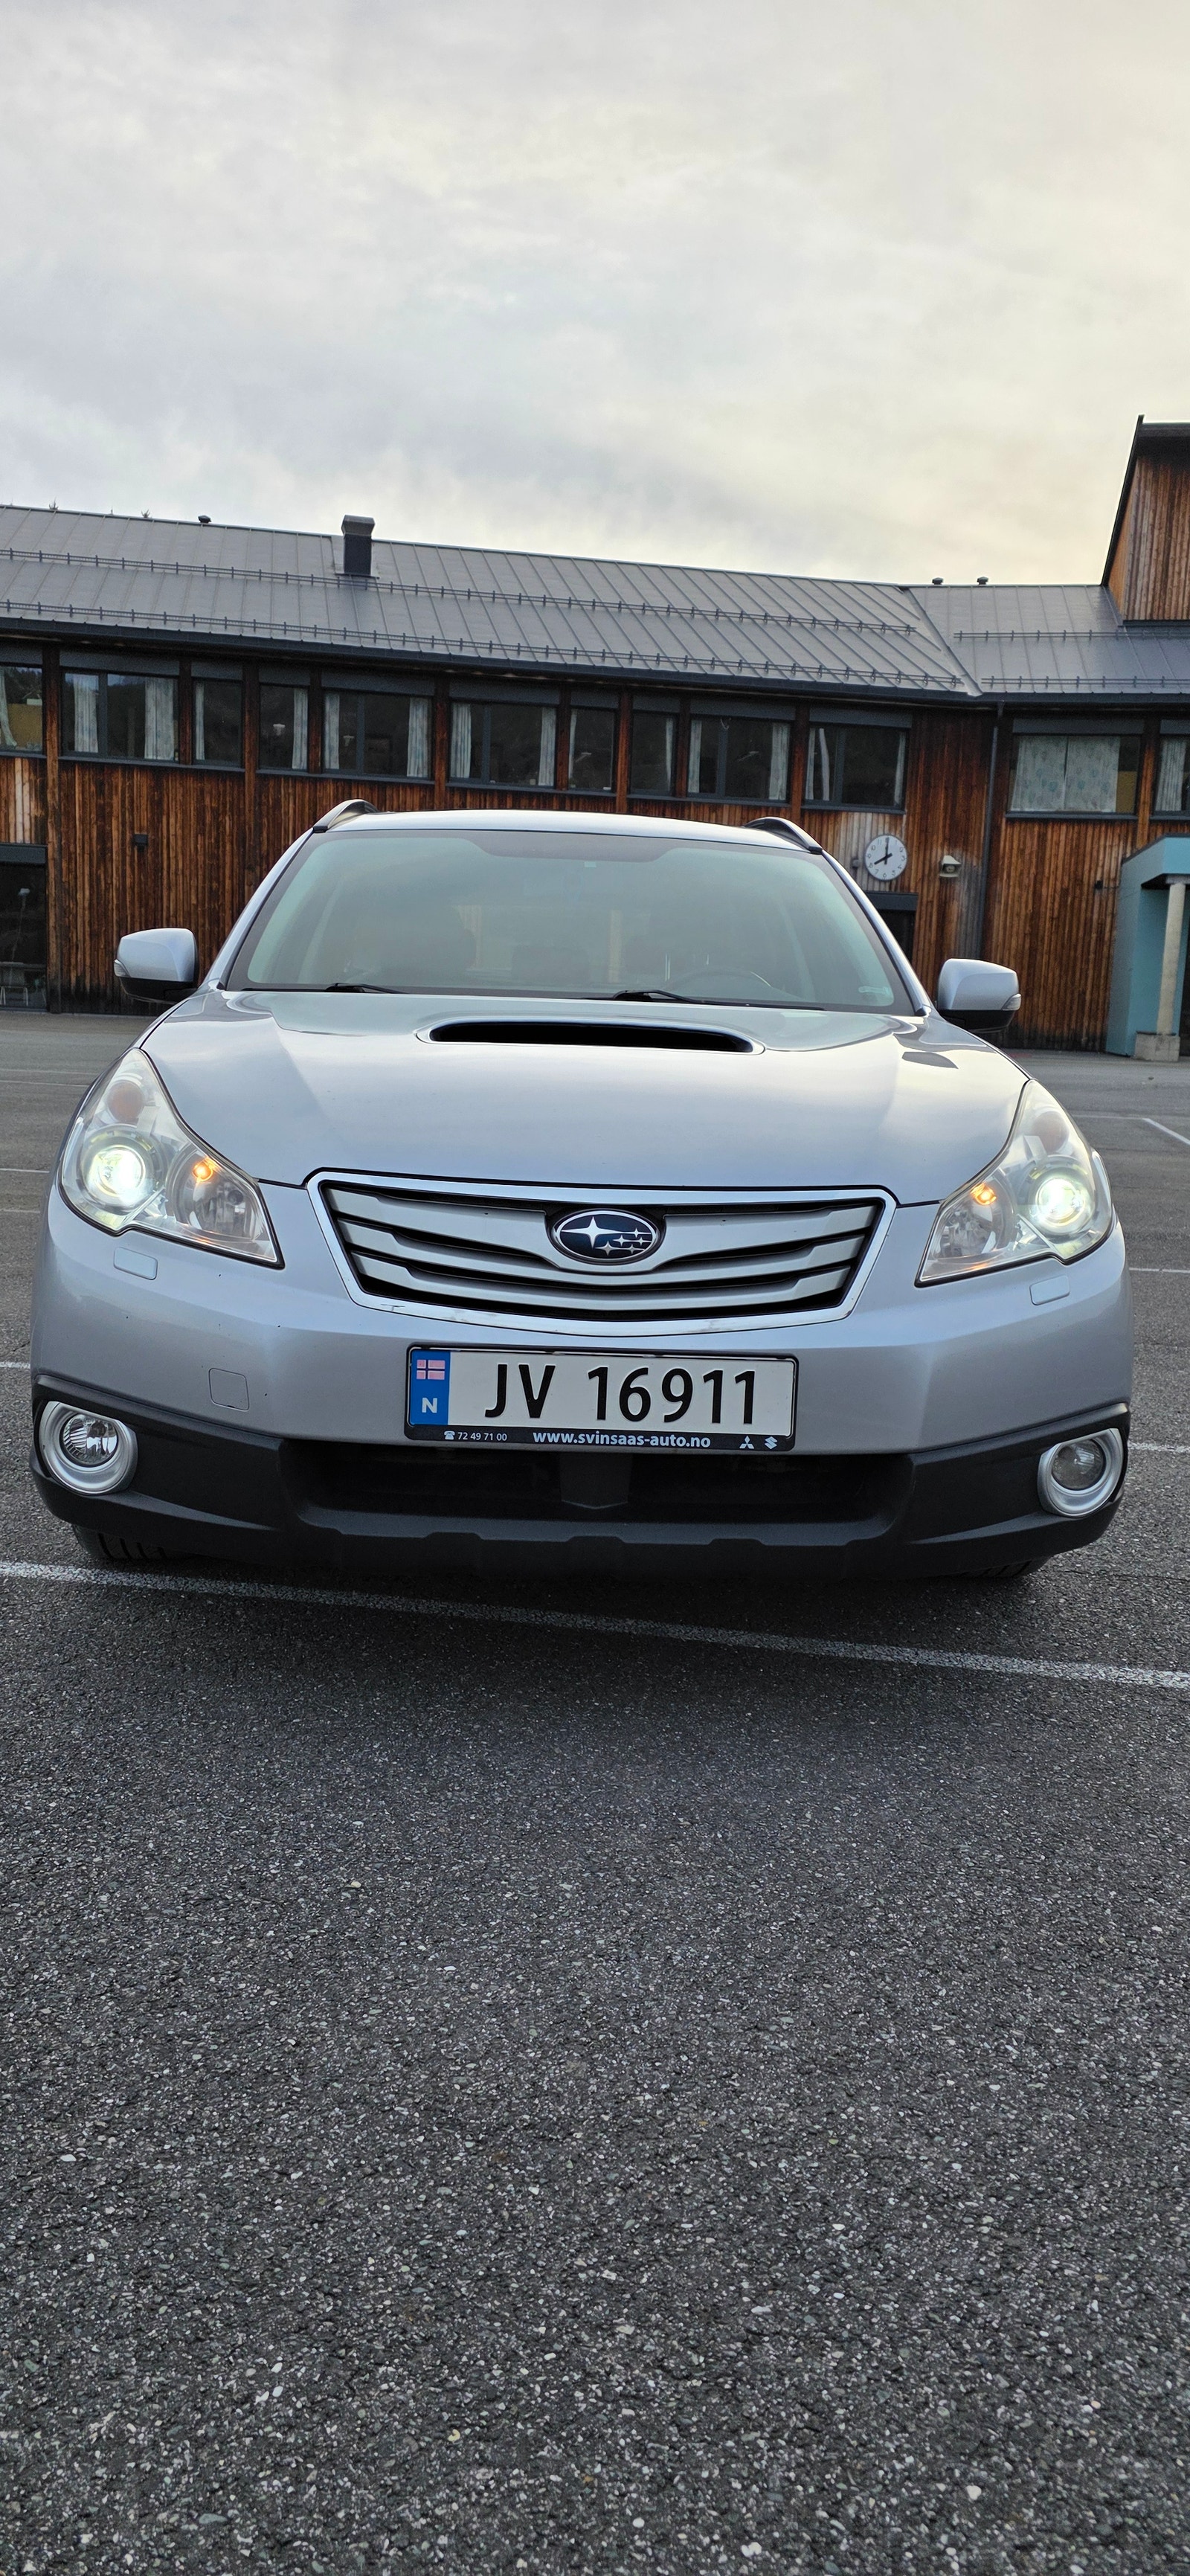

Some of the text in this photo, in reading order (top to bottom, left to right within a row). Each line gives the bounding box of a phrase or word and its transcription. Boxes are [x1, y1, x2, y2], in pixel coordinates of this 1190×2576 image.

[484, 1364, 756, 1424] JV 16911
[421, 1397, 438, 1413] N
[457, 1432, 507, 1441] 72 49 71 00
[533, 1430, 711, 1448] www.svinsaas-auto.no
